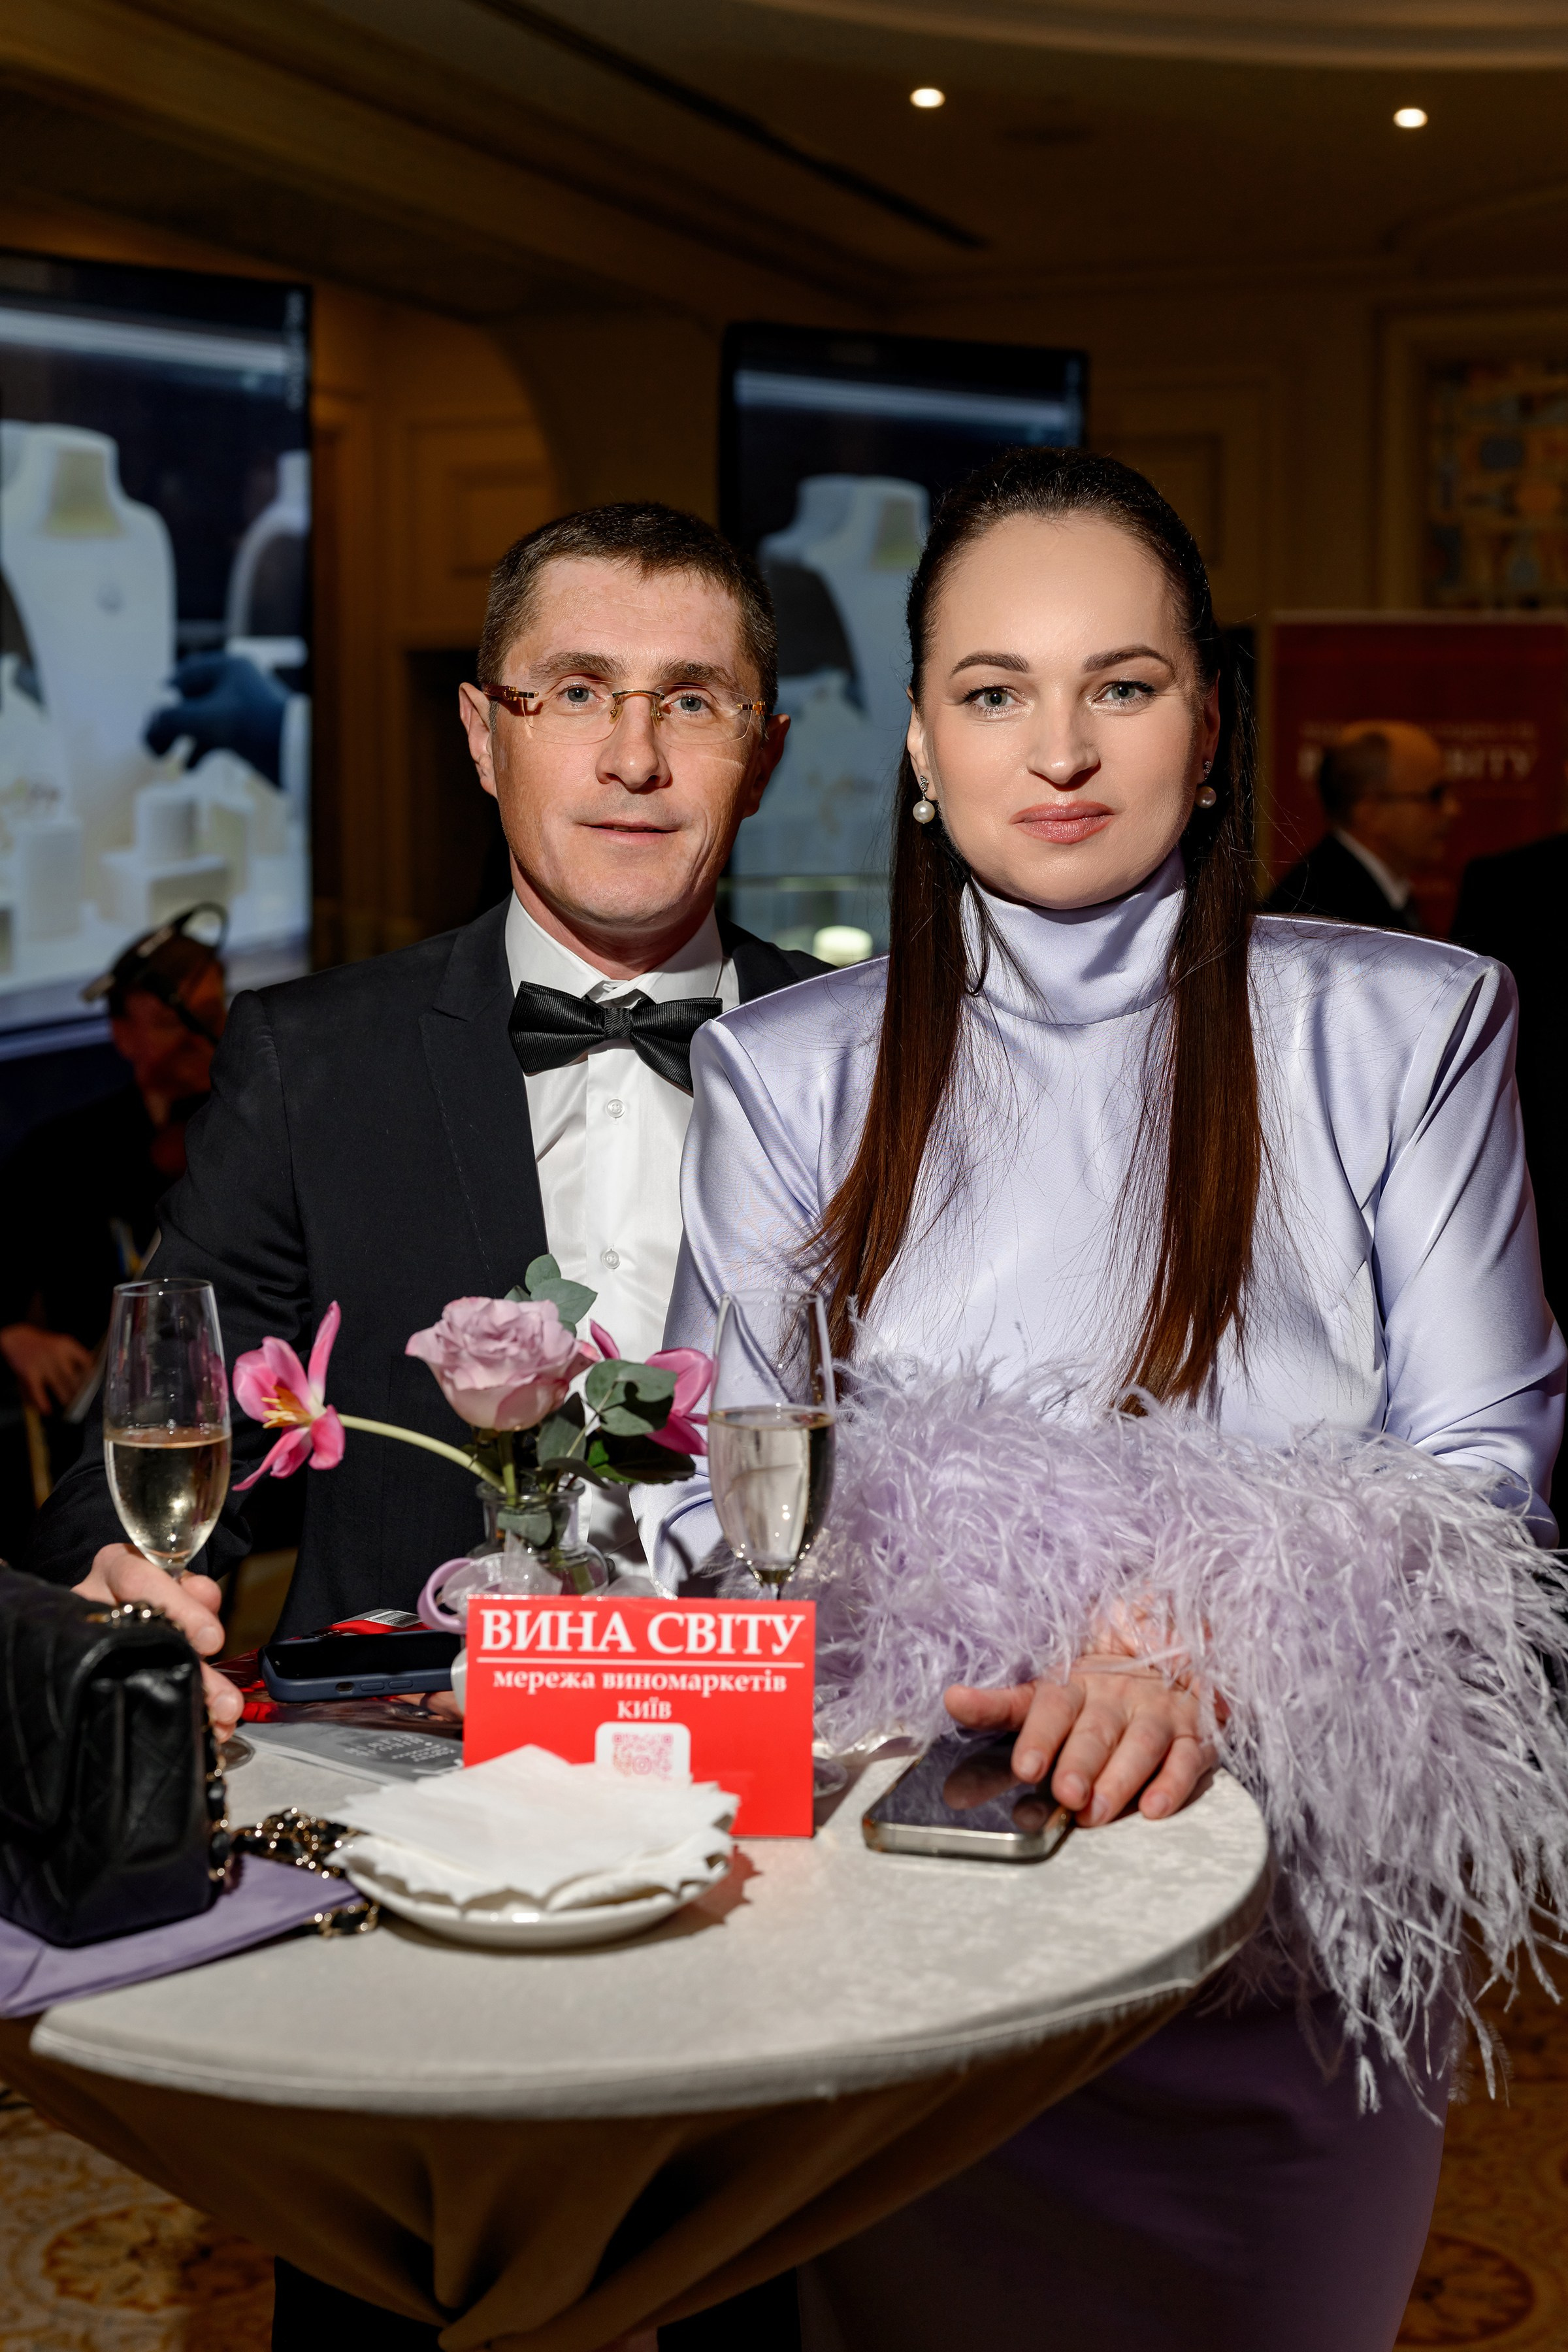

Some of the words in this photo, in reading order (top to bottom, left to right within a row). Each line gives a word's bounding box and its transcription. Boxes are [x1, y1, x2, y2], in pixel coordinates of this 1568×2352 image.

[479, 1609, 636, 1653] ВИНА
[647, 1611, 806, 1656] СВІТУ
[493, 1670, 596, 1695] мережа
[602, 1669, 787, 1697] виномаркетів
